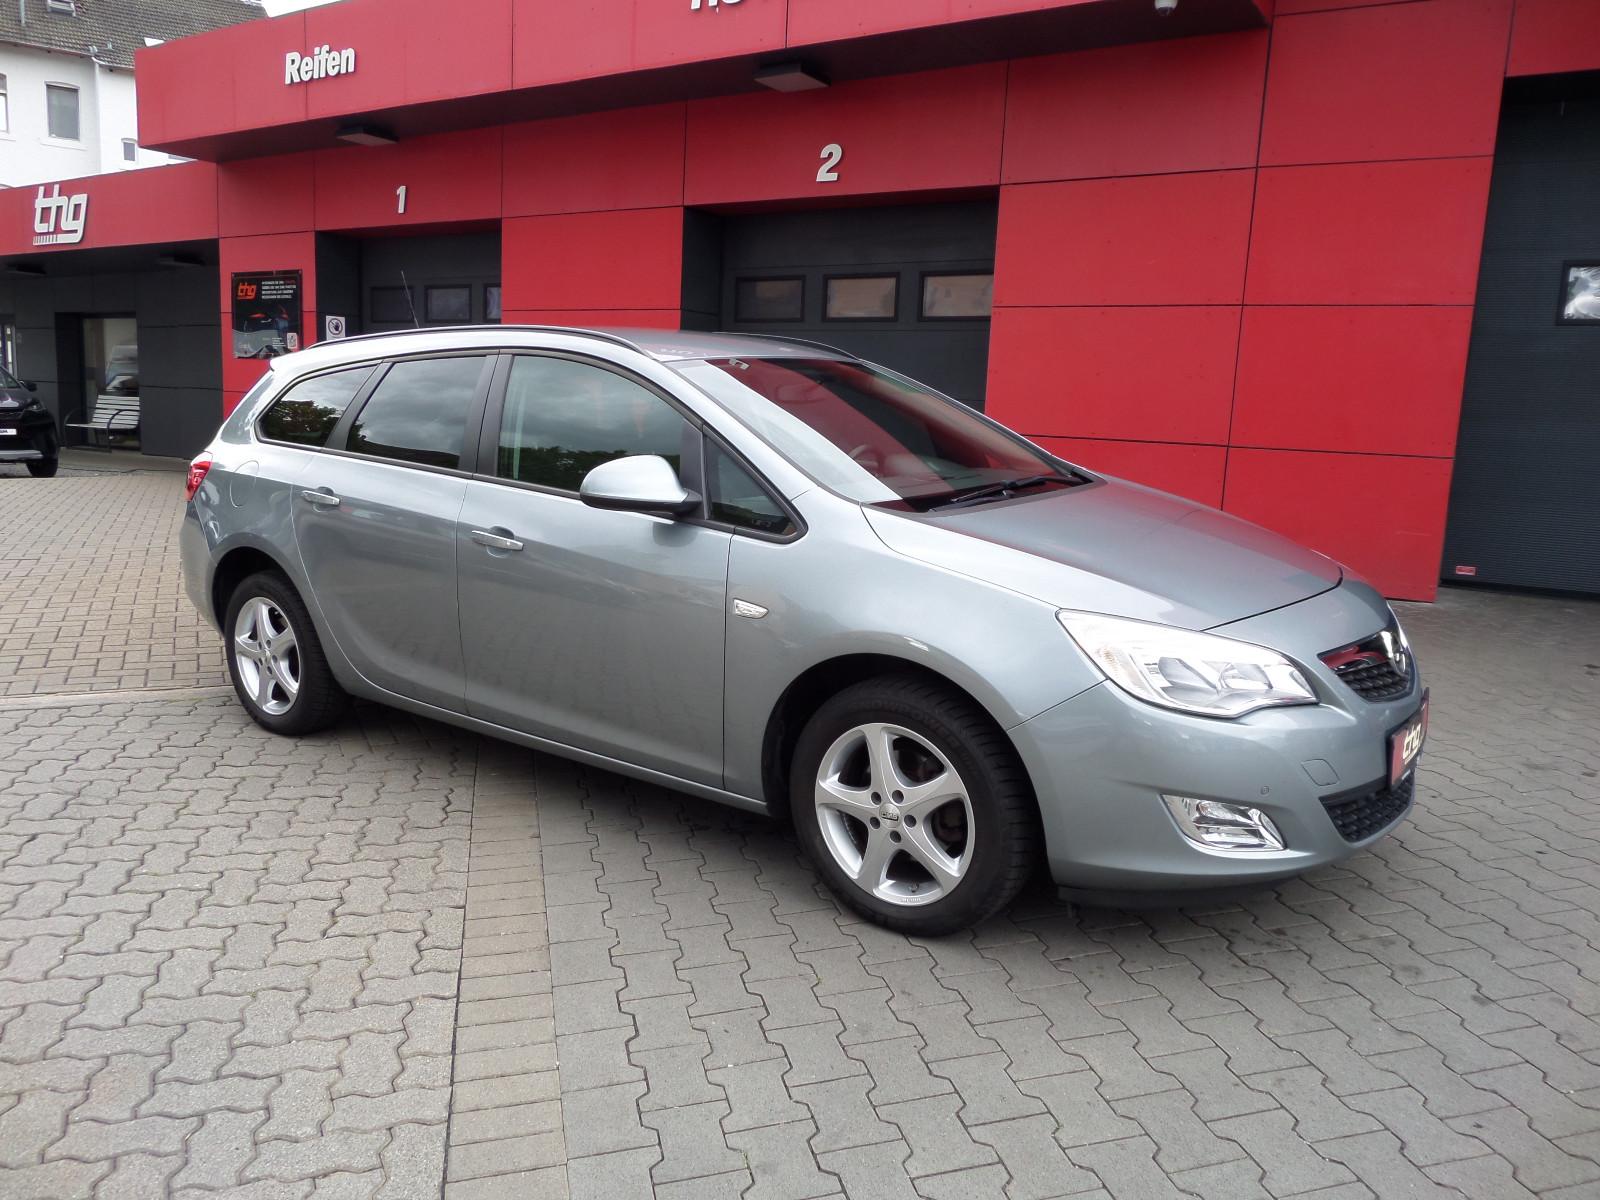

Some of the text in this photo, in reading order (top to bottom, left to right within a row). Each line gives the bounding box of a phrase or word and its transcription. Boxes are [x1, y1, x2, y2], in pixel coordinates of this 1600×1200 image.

[285, 44, 355, 84] Reifen
[816, 143, 842, 181] 2
[33, 184, 88, 245] thg
[397, 185, 407, 213] 1
